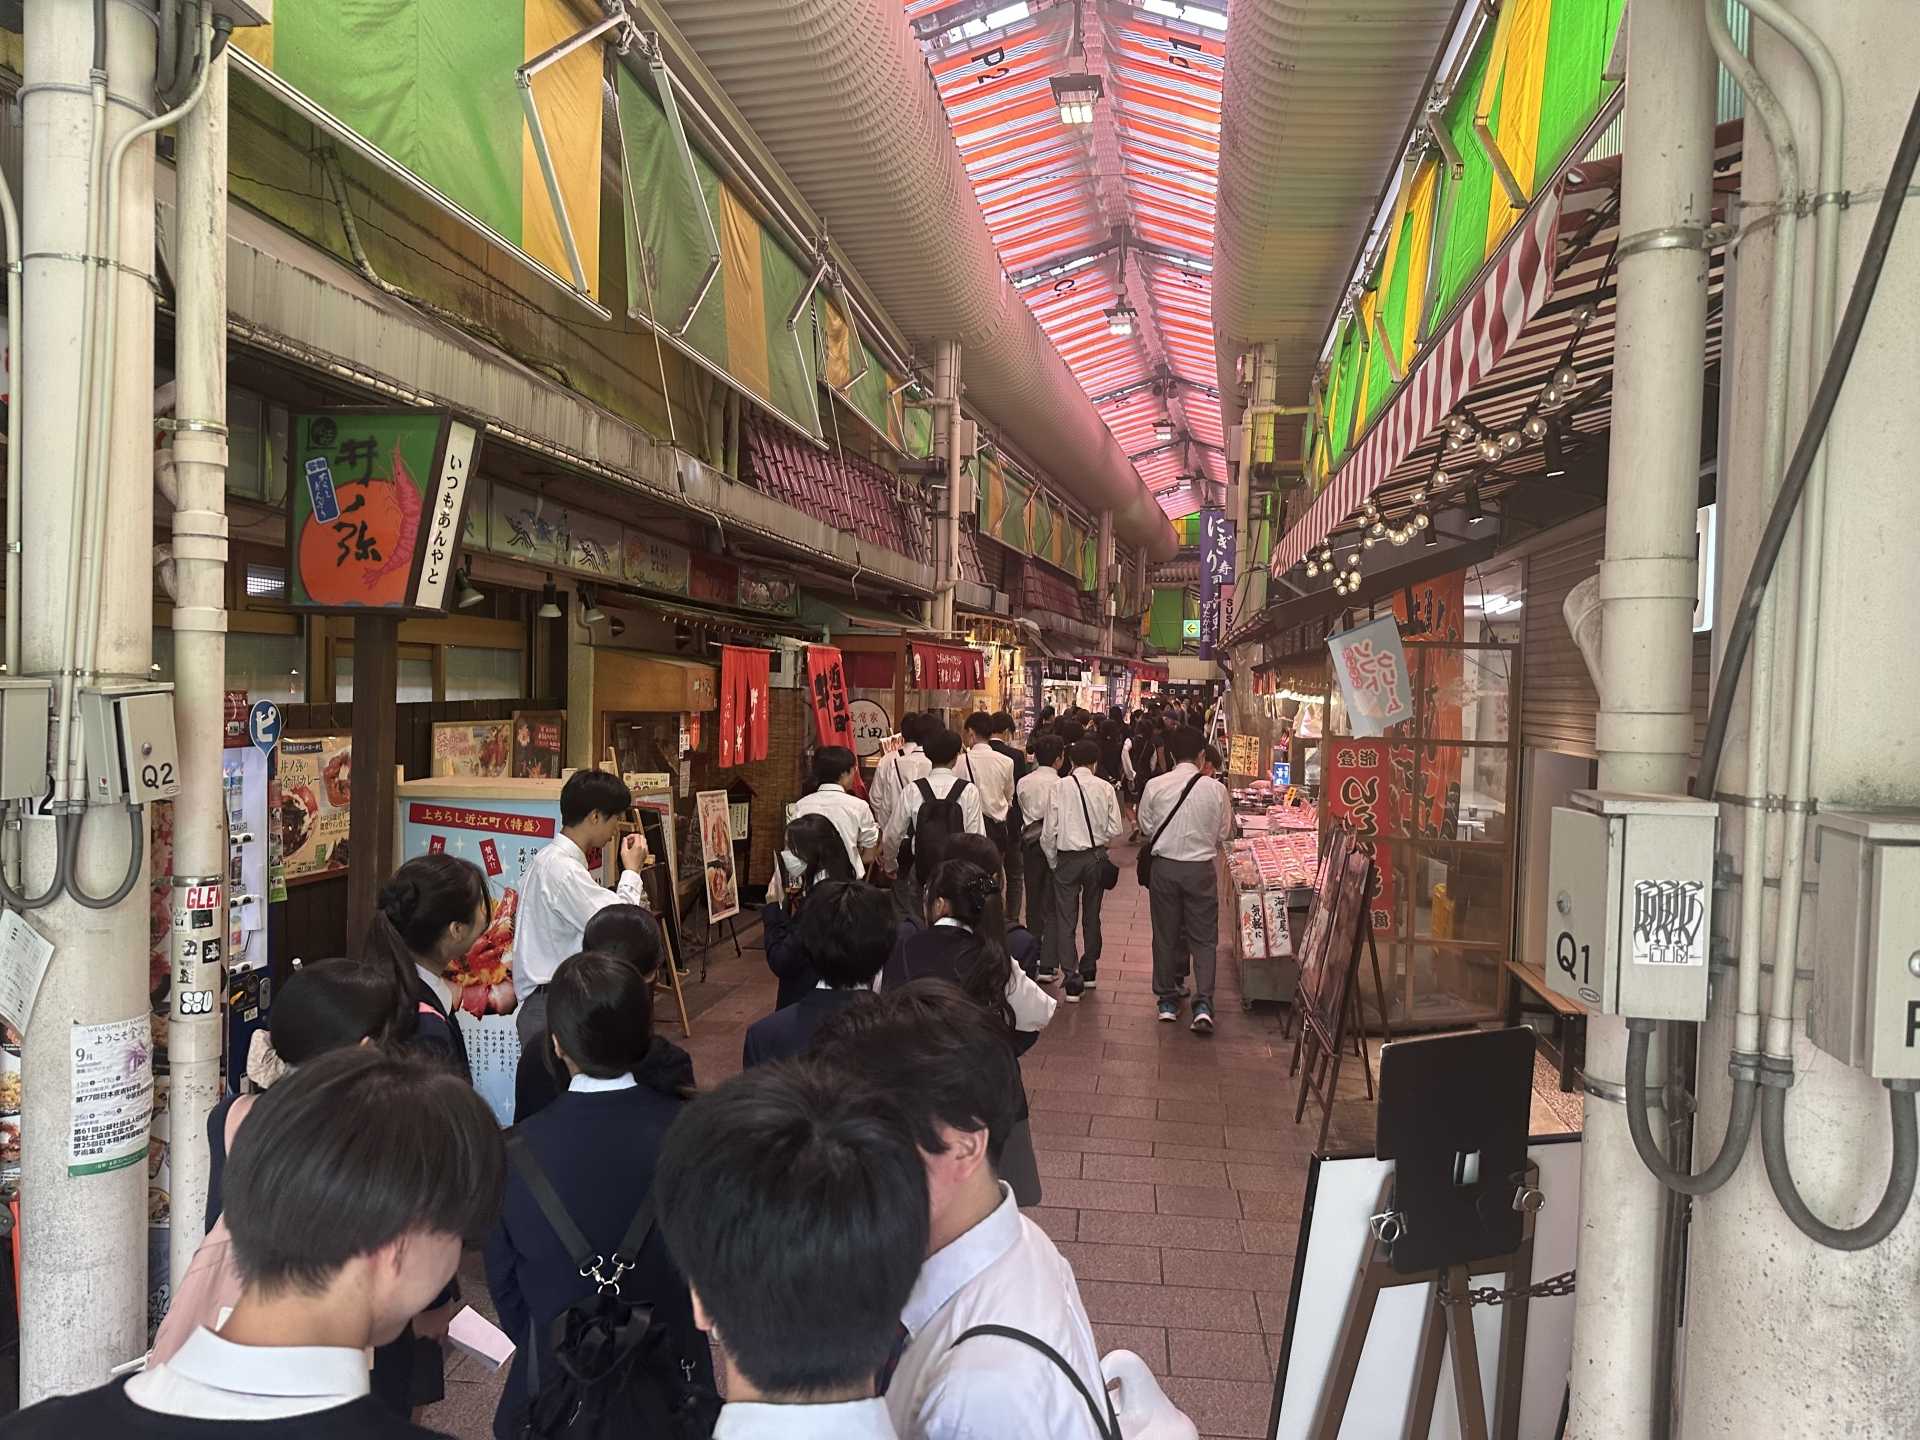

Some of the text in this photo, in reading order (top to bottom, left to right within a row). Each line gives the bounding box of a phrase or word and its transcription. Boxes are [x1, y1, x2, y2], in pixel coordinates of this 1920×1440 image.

[428, 455, 462, 585] いつもあんやと
[1206, 516, 1233, 585] にぎり寿司
[1225, 598, 1234, 633] SUSH
[142, 762, 175, 789] Q2
[422, 809, 541, 833] 上ちらし近江町〈特盛〉
[1556, 931, 1590, 984] Q1
